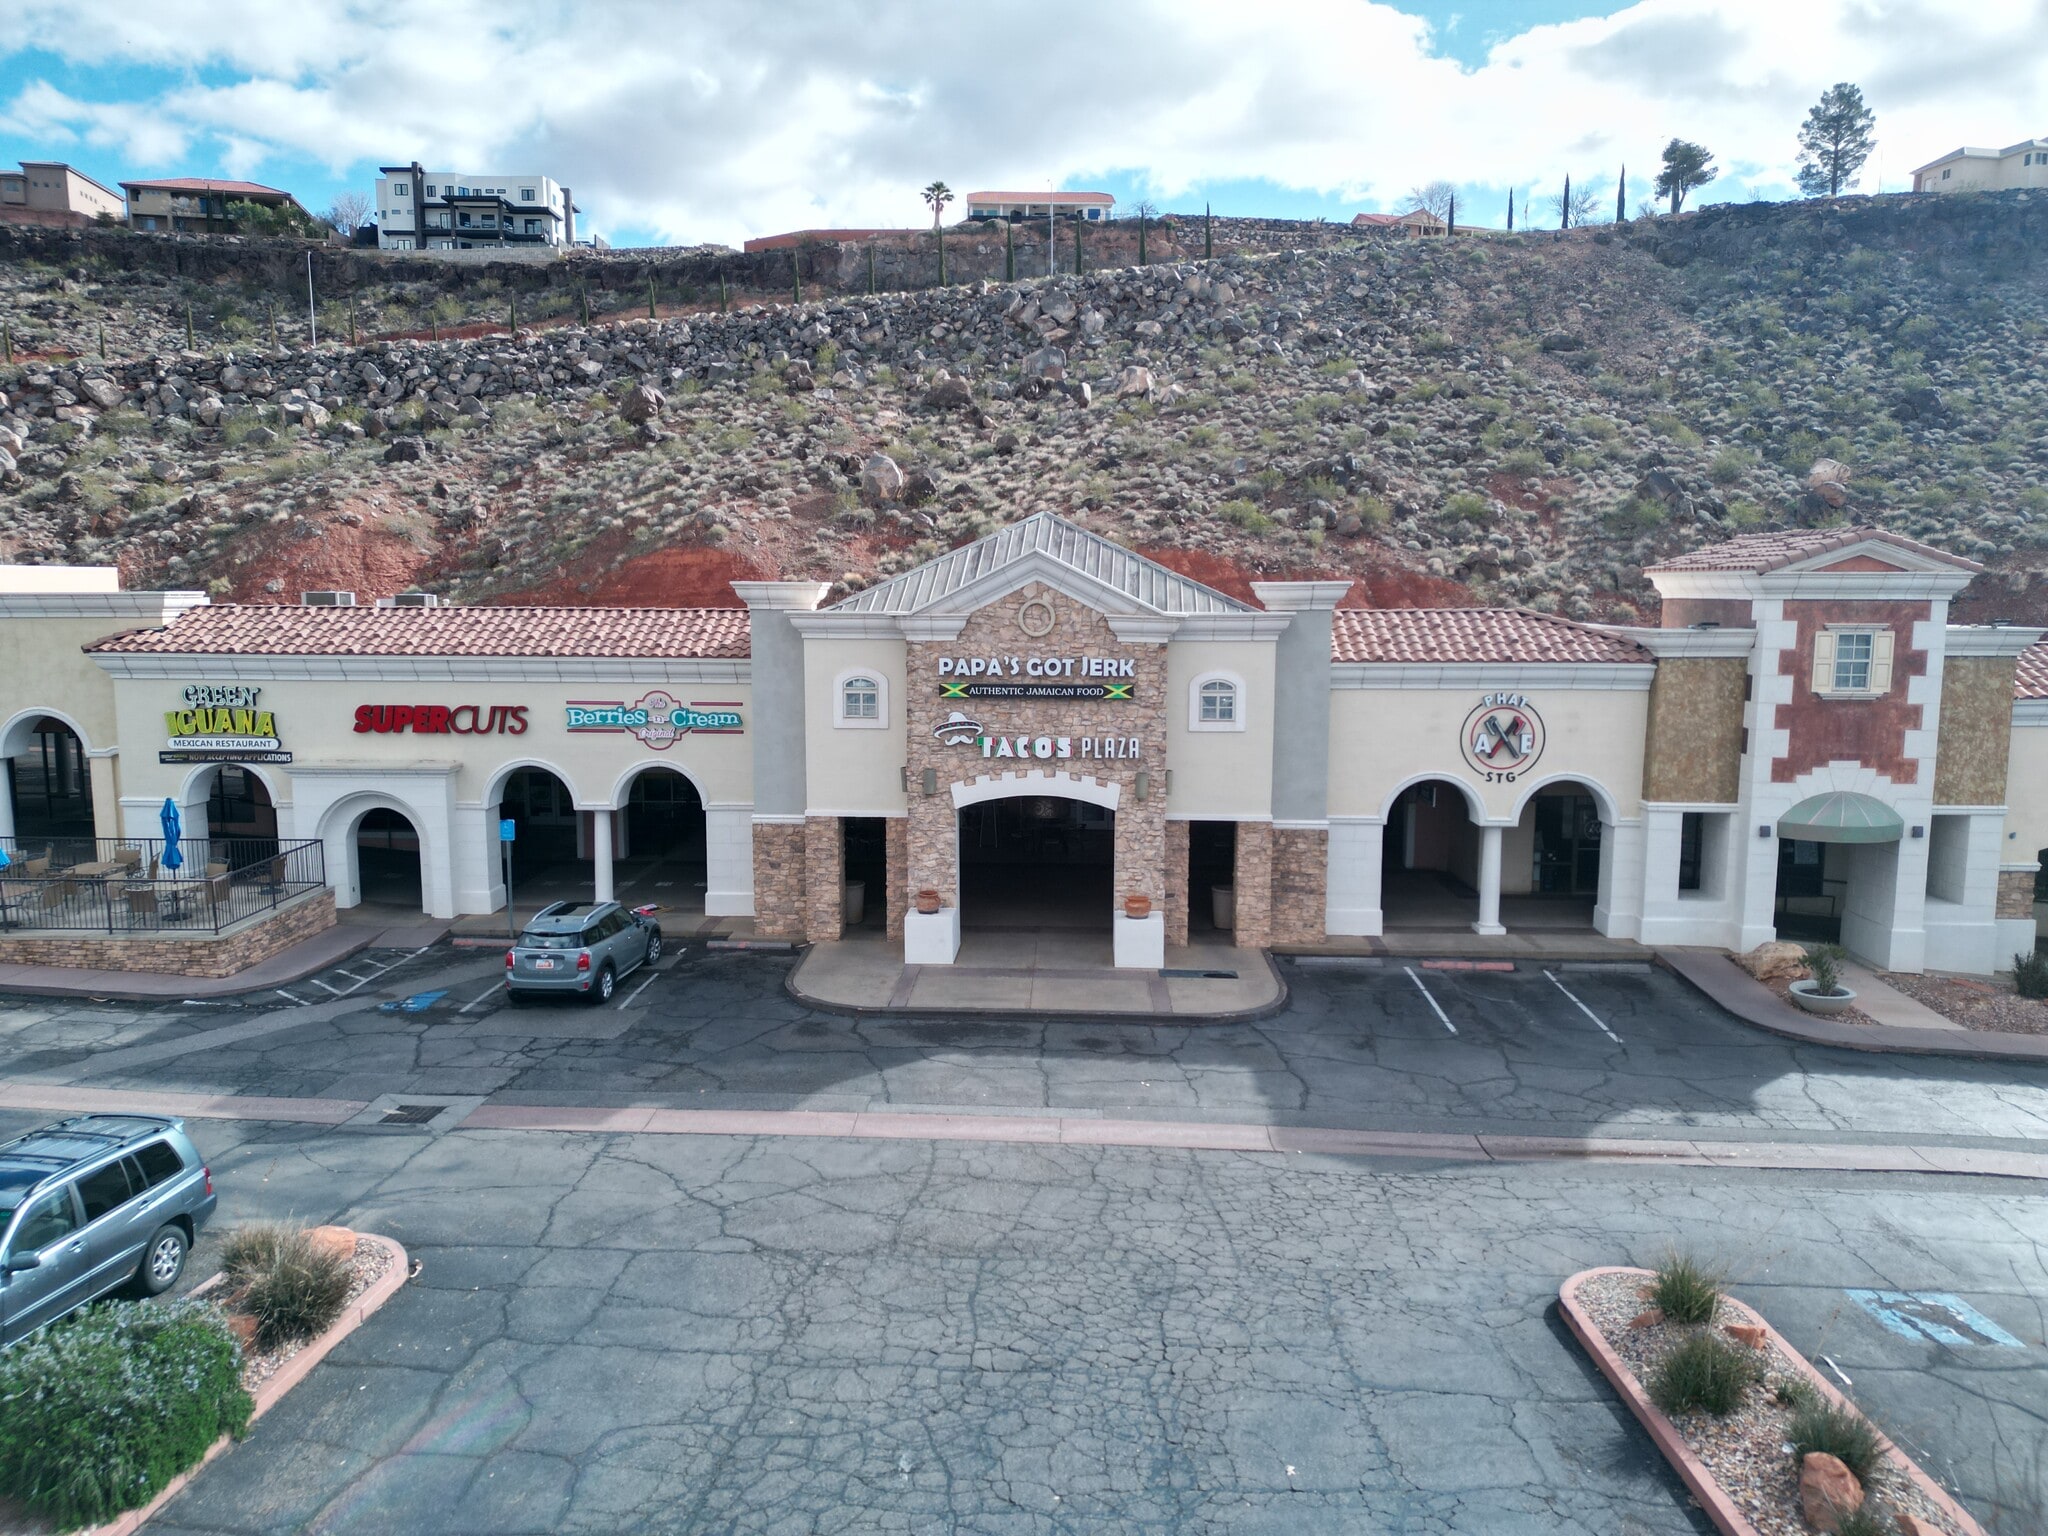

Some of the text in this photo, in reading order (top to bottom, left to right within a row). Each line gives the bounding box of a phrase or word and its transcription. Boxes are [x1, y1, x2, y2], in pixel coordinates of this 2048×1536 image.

[938, 656, 1135, 677] PAPA'S GOT JERK
[182, 685, 261, 708] GREEN
[969, 686, 1104, 696] AUTHENTIC JAMAICAN FOOD
[1483, 692, 1529, 708] PHAT
[164, 708, 277, 737] IGUANA
[353, 704, 529, 735] SUPERCUTS
[566, 707, 648, 727] Berries
[670, 708, 743, 728] Cream
[173, 739, 272, 748] MEXICAN RESTAURANT
[639, 727, 676, 741] Original
[977, 736, 1140, 759] TACOS PLAZA
[1486, 772, 1516, 783] STG
